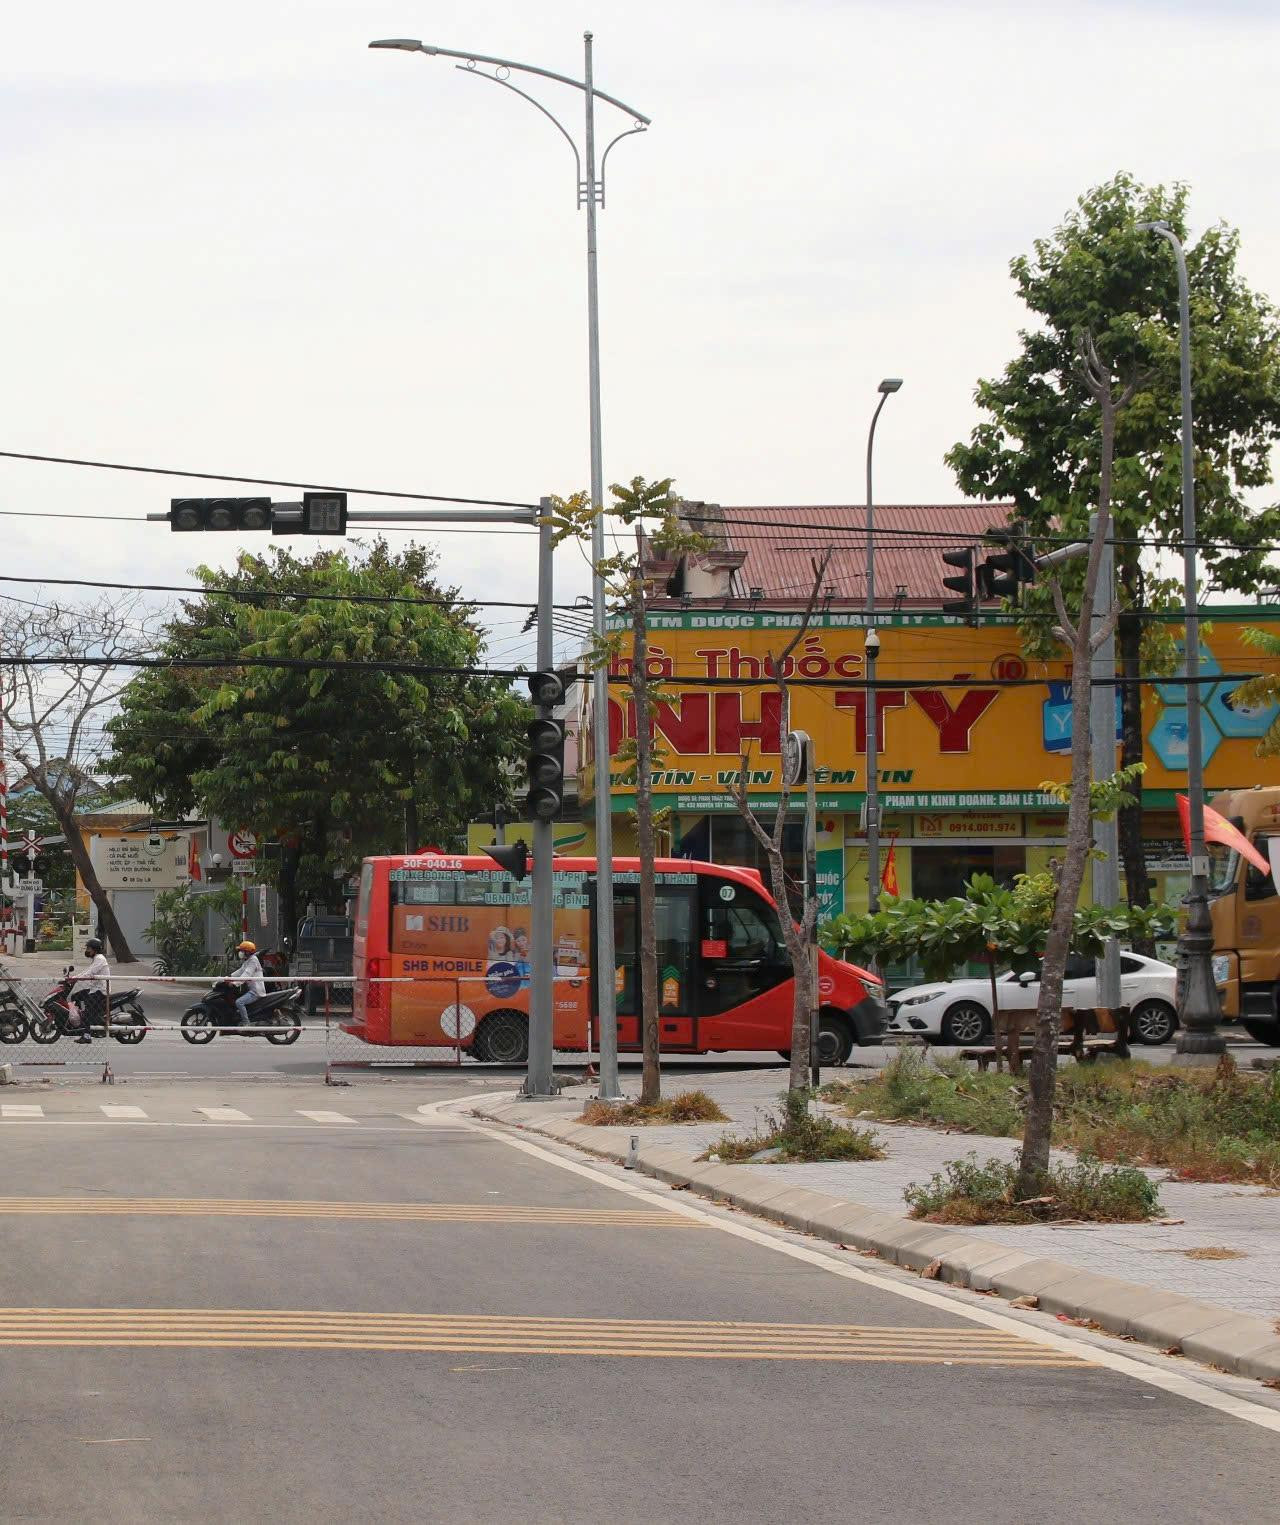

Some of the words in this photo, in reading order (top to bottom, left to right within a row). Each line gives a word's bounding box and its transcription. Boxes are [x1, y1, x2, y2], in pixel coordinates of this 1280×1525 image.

[695, 636, 862, 679] Thuốc
[650, 768, 696, 785] TÍN
[931, 794, 956, 806] KINH
[403, 859, 463, 869] 50F-040.16
[428, 915, 469, 932] SHB
[403, 961, 429, 972] SHB
[432, 961, 483, 972] MOBILE
